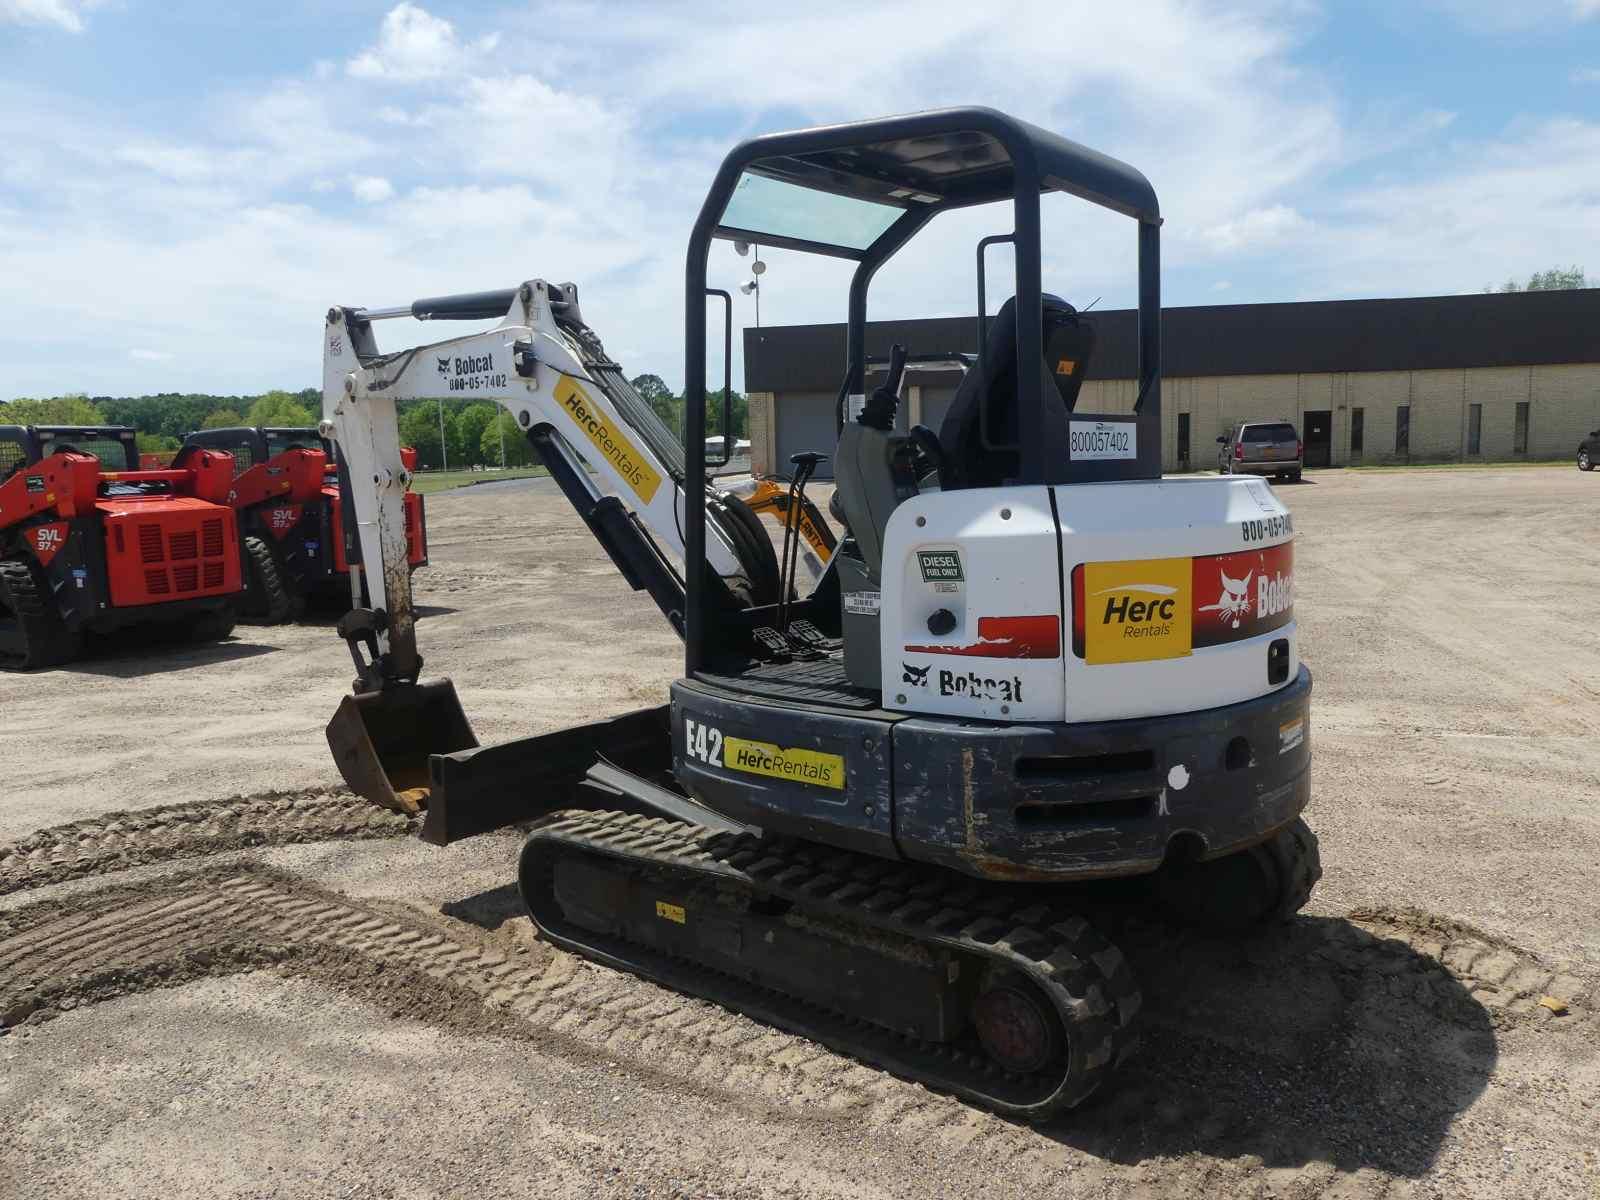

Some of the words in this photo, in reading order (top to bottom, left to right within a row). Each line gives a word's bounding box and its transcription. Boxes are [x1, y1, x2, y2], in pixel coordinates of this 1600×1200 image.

[455, 353, 493, 376] Bobcat
[1071, 432, 1129, 452] 800057402
[272, 510, 297, 520] SVL
[37, 528, 63, 541] SVL
[923, 556, 958, 567] DIESEL
[926, 568, 942, 577] FUEL
[942, 568, 958, 577] ONLY
[1103, 596, 1176, 625] Herc
[1123, 623, 1170, 639] Rentals
[686, 718, 723, 768] E42
